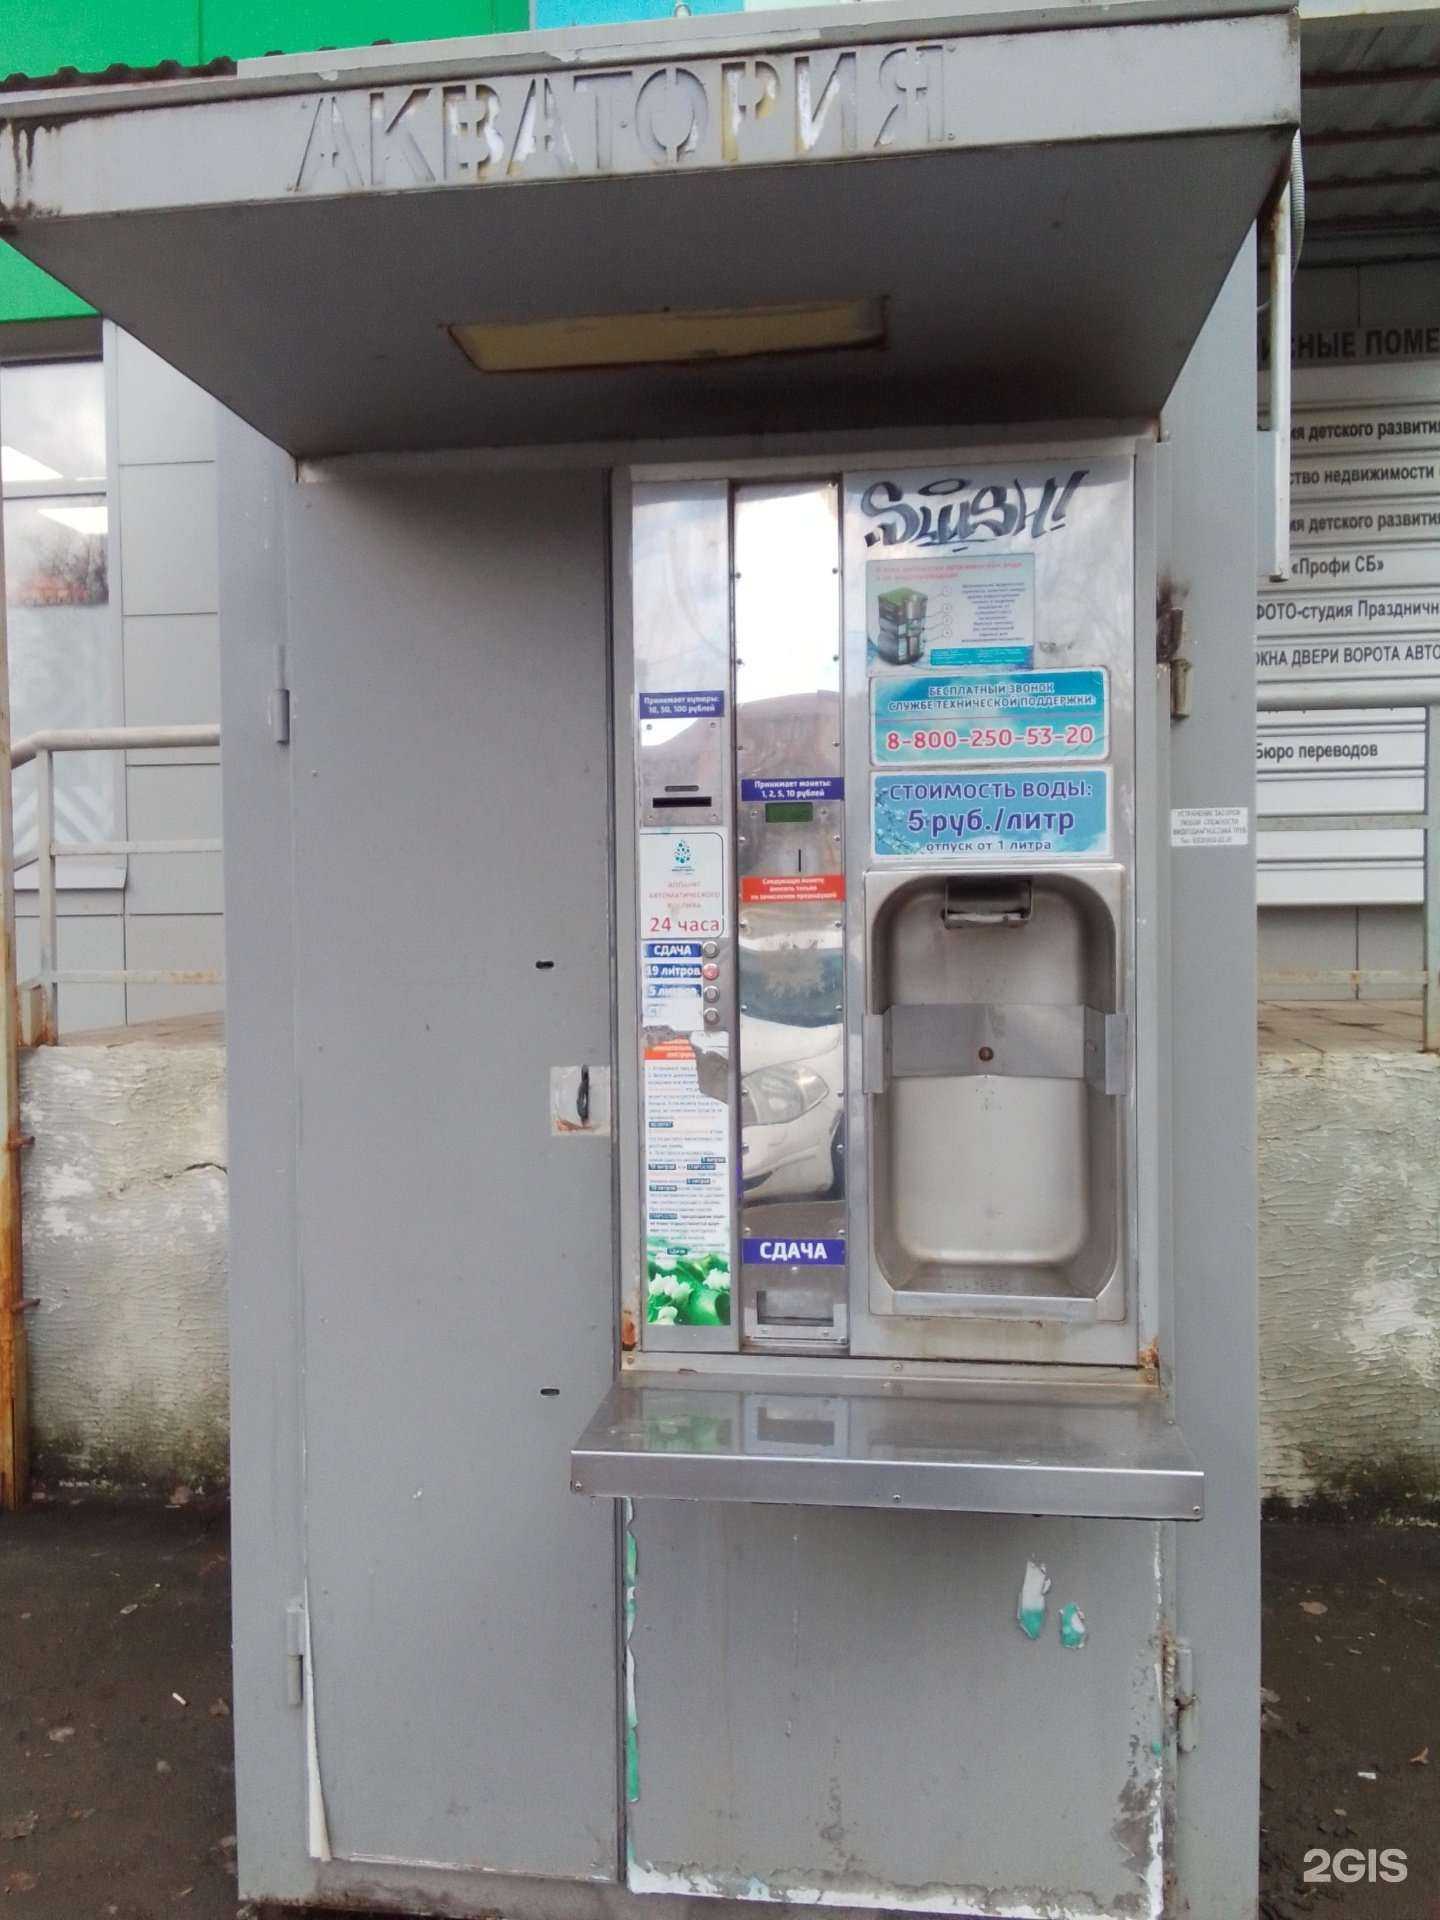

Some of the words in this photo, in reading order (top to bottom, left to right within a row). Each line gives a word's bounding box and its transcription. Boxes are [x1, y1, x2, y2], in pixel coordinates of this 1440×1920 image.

[294, 44, 947, 193] АКВАТОРИЯ
[1308, 423, 1374, 442] детского
[1324, 466, 1434, 486] недвижимости
[1308, 515, 1374, 534] детского
[1291, 556, 1351, 578] «Профи
[1354, 554, 1384, 573] СБ»
[1291, 648, 1339, 667] ДВЕРИ
[1343, 646, 1400, 663] ВОРОТА
[929, 685, 1006, 697] БЕСПЛАТНЫЙ
[1009, 683, 1055, 695] ЗВОНОК
[935, 696, 1018, 711] ТЕХНИЧЕСКОЙ
[887, 727, 1095, 750] 8-800-250-53-20
[1298, 742, 1378, 762] переводов
[890, 783, 1015, 800] СТОИМОСТЬ
[1022, 781, 1093, 798] ВОДЫ:
[908, 809, 924, 832] 5
[931, 808, 1075, 837] руб./литр
[926, 841, 973, 852] отпуск
[977, 842, 992, 851] от
[998, 841, 1004, 850] 1
[1009, 840, 1051, 851] литра
[650, 917, 671, 932] 24
[677, 919, 720, 932] часа
[653, 945, 692, 957] СДАЧА
[759, 1242, 828, 1261] СДАЧА
